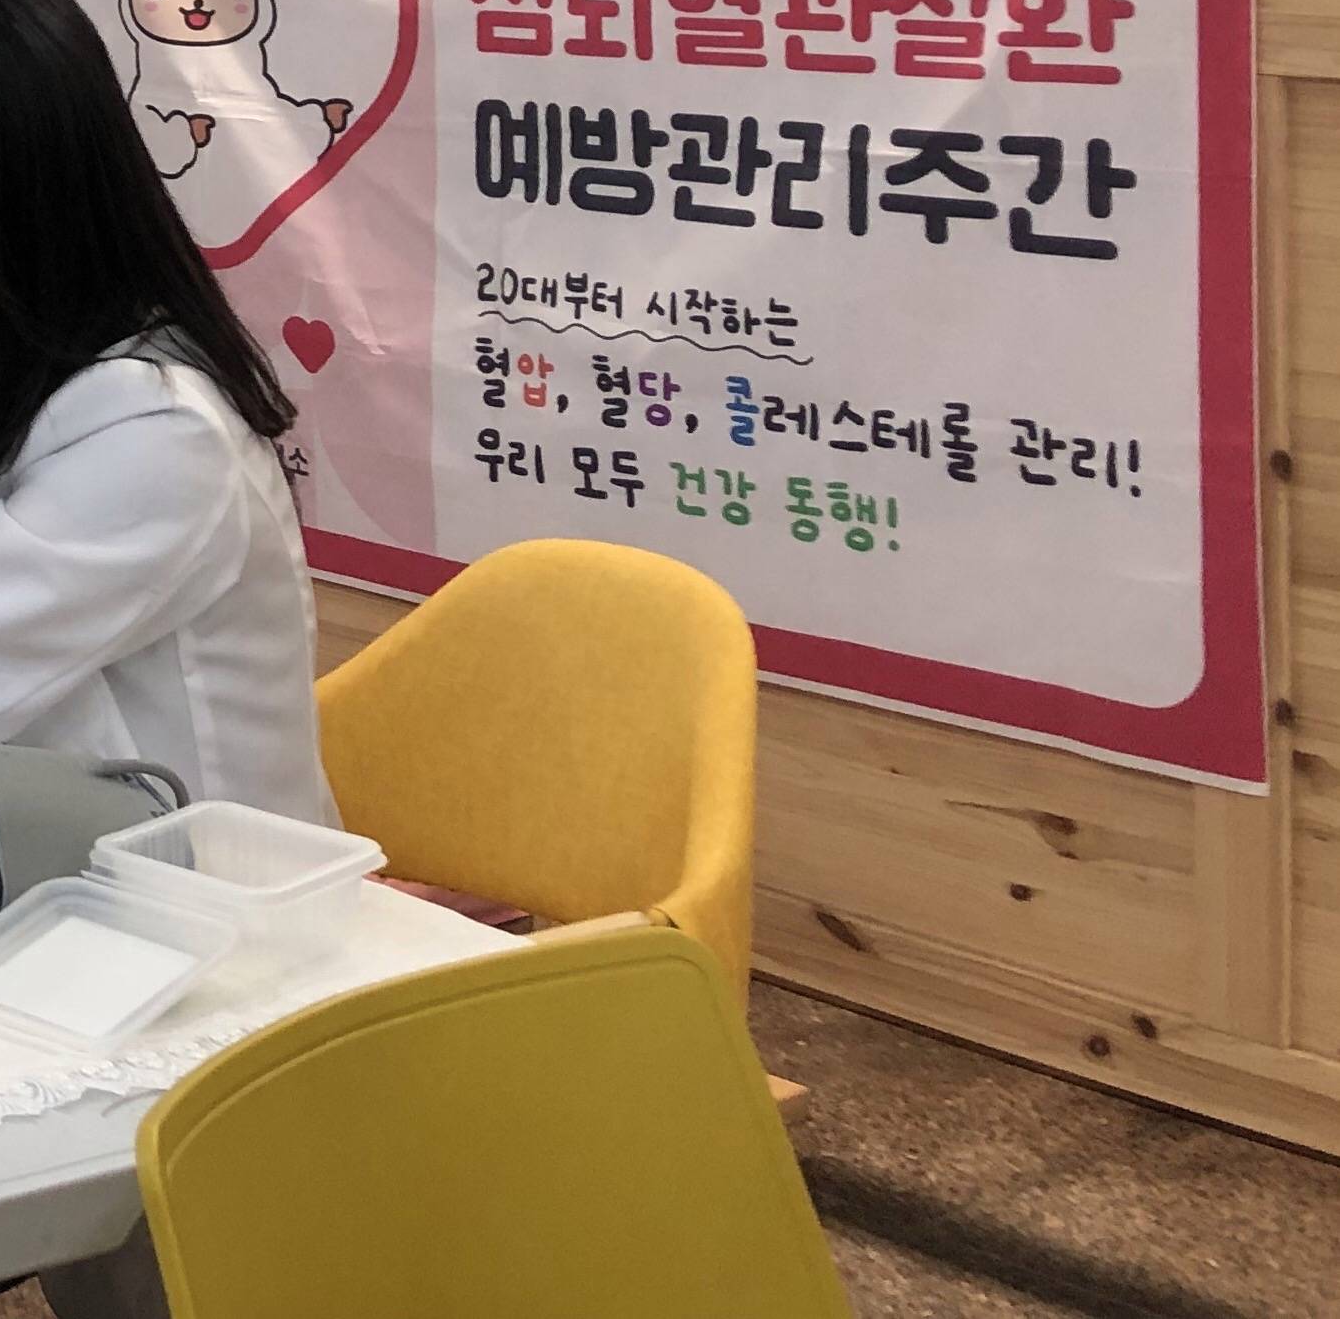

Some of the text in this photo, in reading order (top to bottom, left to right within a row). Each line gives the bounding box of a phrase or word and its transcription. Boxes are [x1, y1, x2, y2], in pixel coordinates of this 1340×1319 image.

[474, 98, 1138, 261] 예방관리주간
[476, 262, 799, 347] 20대부터 시작하는
[474, 336, 1143, 499] 혈압, 혈당, 콜레스테롤 관리!
[474, 427, 901, 553] 우리 모두 건강 동행!
